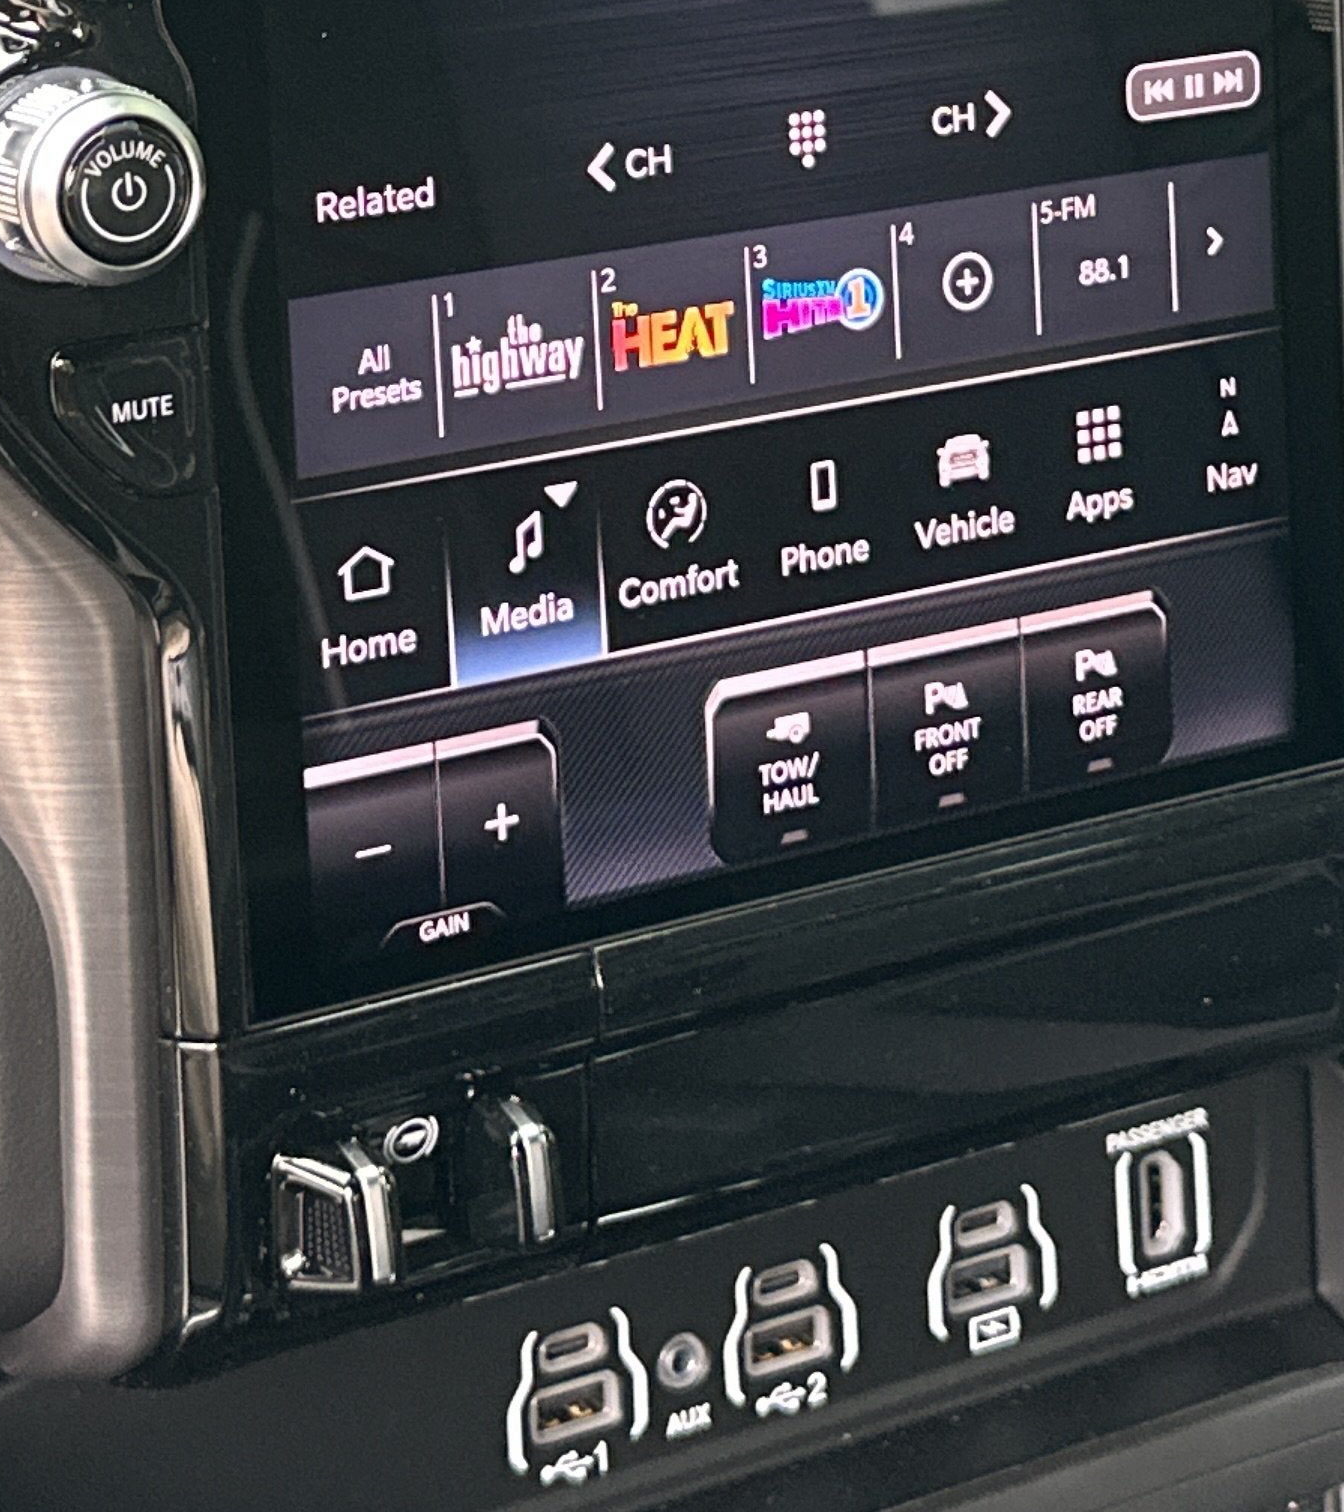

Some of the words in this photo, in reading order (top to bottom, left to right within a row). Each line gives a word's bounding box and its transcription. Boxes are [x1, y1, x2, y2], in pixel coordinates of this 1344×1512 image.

[931, 103, 976, 136] CH
[84, 140, 167, 179] VOLUME
[624, 144, 674, 178] CH
[316, 176, 436, 222] Related
[1039, 194, 1096, 224] 5-FM
[898, 223, 915, 245] 4
[752, 244, 768, 268] 3
[1078, 254, 1131, 287] 88.1
[507, 313, 542, 346] the
[611, 300, 735, 371] HEAT
[358, 344, 391, 376] All
[451, 336, 585, 395] highway
[111, 393, 174, 423] MUTE
[331, 377, 423, 414] Presets
[1206, 462, 1258, 493] Nav
[1066, 486, 1134, 524] Apps
[914, 505, 1015, 550] Vehicle
[780, 538, 870, 577] Phone
[618, 558, 740, 609] Comfort
[480, 593, 574, 636] Media
[320, 627, 418, 669] Home
[1072, 686, 1123, 717] REAR
[913, 717, 982, 752] FRONT
[1078, 713, 1118, 743] OFF
[759, 752, 820, 787] TOW/
[929, 747, 969, 777] OFF
[762, 783, 820, 815] HAUL
[418, 912, 471, 943] GAIN
[665, 1402, 712, 1438] AUX
